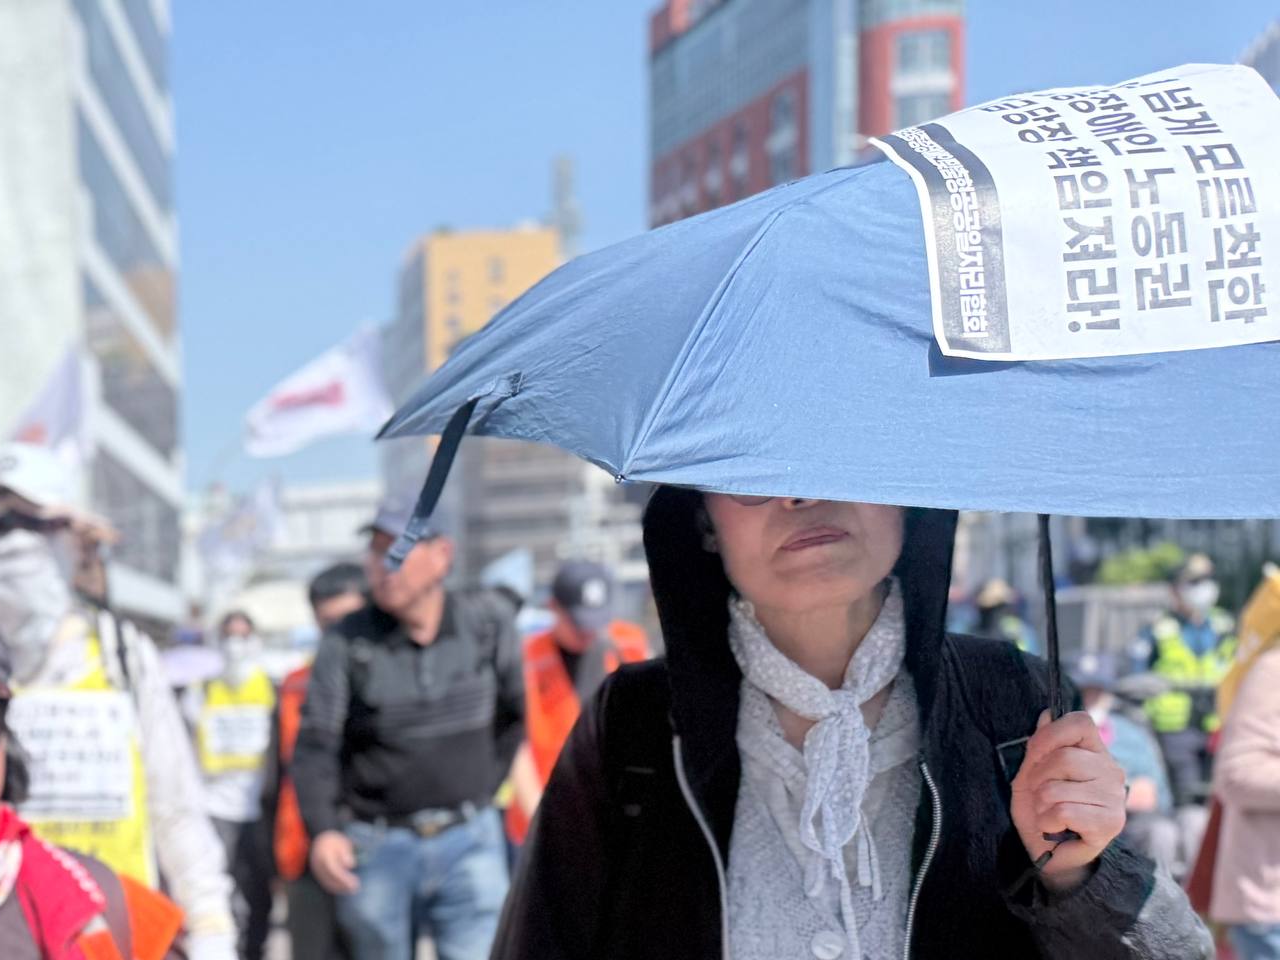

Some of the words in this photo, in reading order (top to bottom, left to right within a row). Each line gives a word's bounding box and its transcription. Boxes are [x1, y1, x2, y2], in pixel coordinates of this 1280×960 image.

[1046, 146, 1121, 332] 책임져라!
[1122, 168, 1192, 311] 노동권
[1138, 86, 1224, 136] 넘게
[1181, 143, 1268, 325] 모른척한
